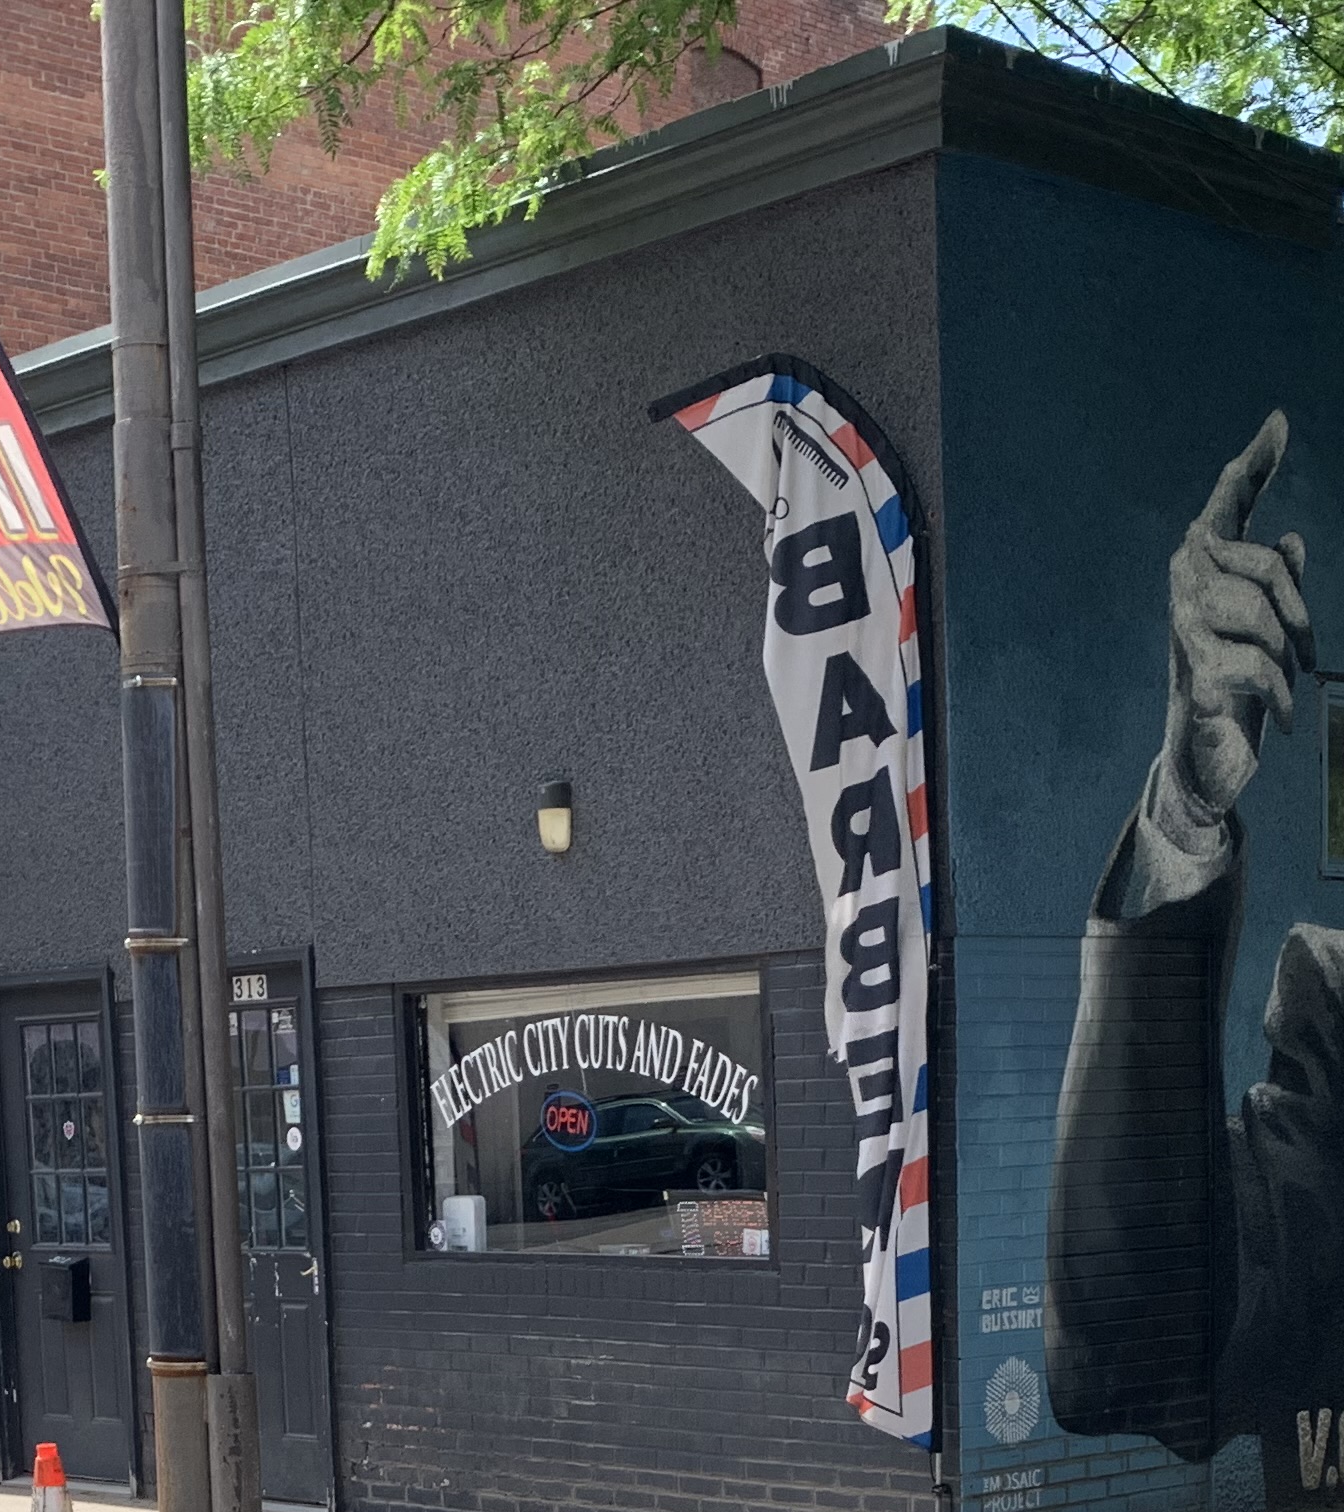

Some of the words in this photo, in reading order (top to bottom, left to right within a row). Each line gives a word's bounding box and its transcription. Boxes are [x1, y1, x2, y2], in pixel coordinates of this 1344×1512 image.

[234, 976, 266, 999] 313
[430, 1030, 524, 1129] ELECTRIC
[523, 1014, 573, 1077] CITY
[573, 1013, 629, 1071] CUTS
[630, 1019, 683, 1084] AND
[683, 1039, 759, 1125] FADES
[545, 1105, 590, 1136] OPEN
[982, 1287, 1018, 1311] ERIC
[989, 1468, 1042, 1493] MOSAIC
